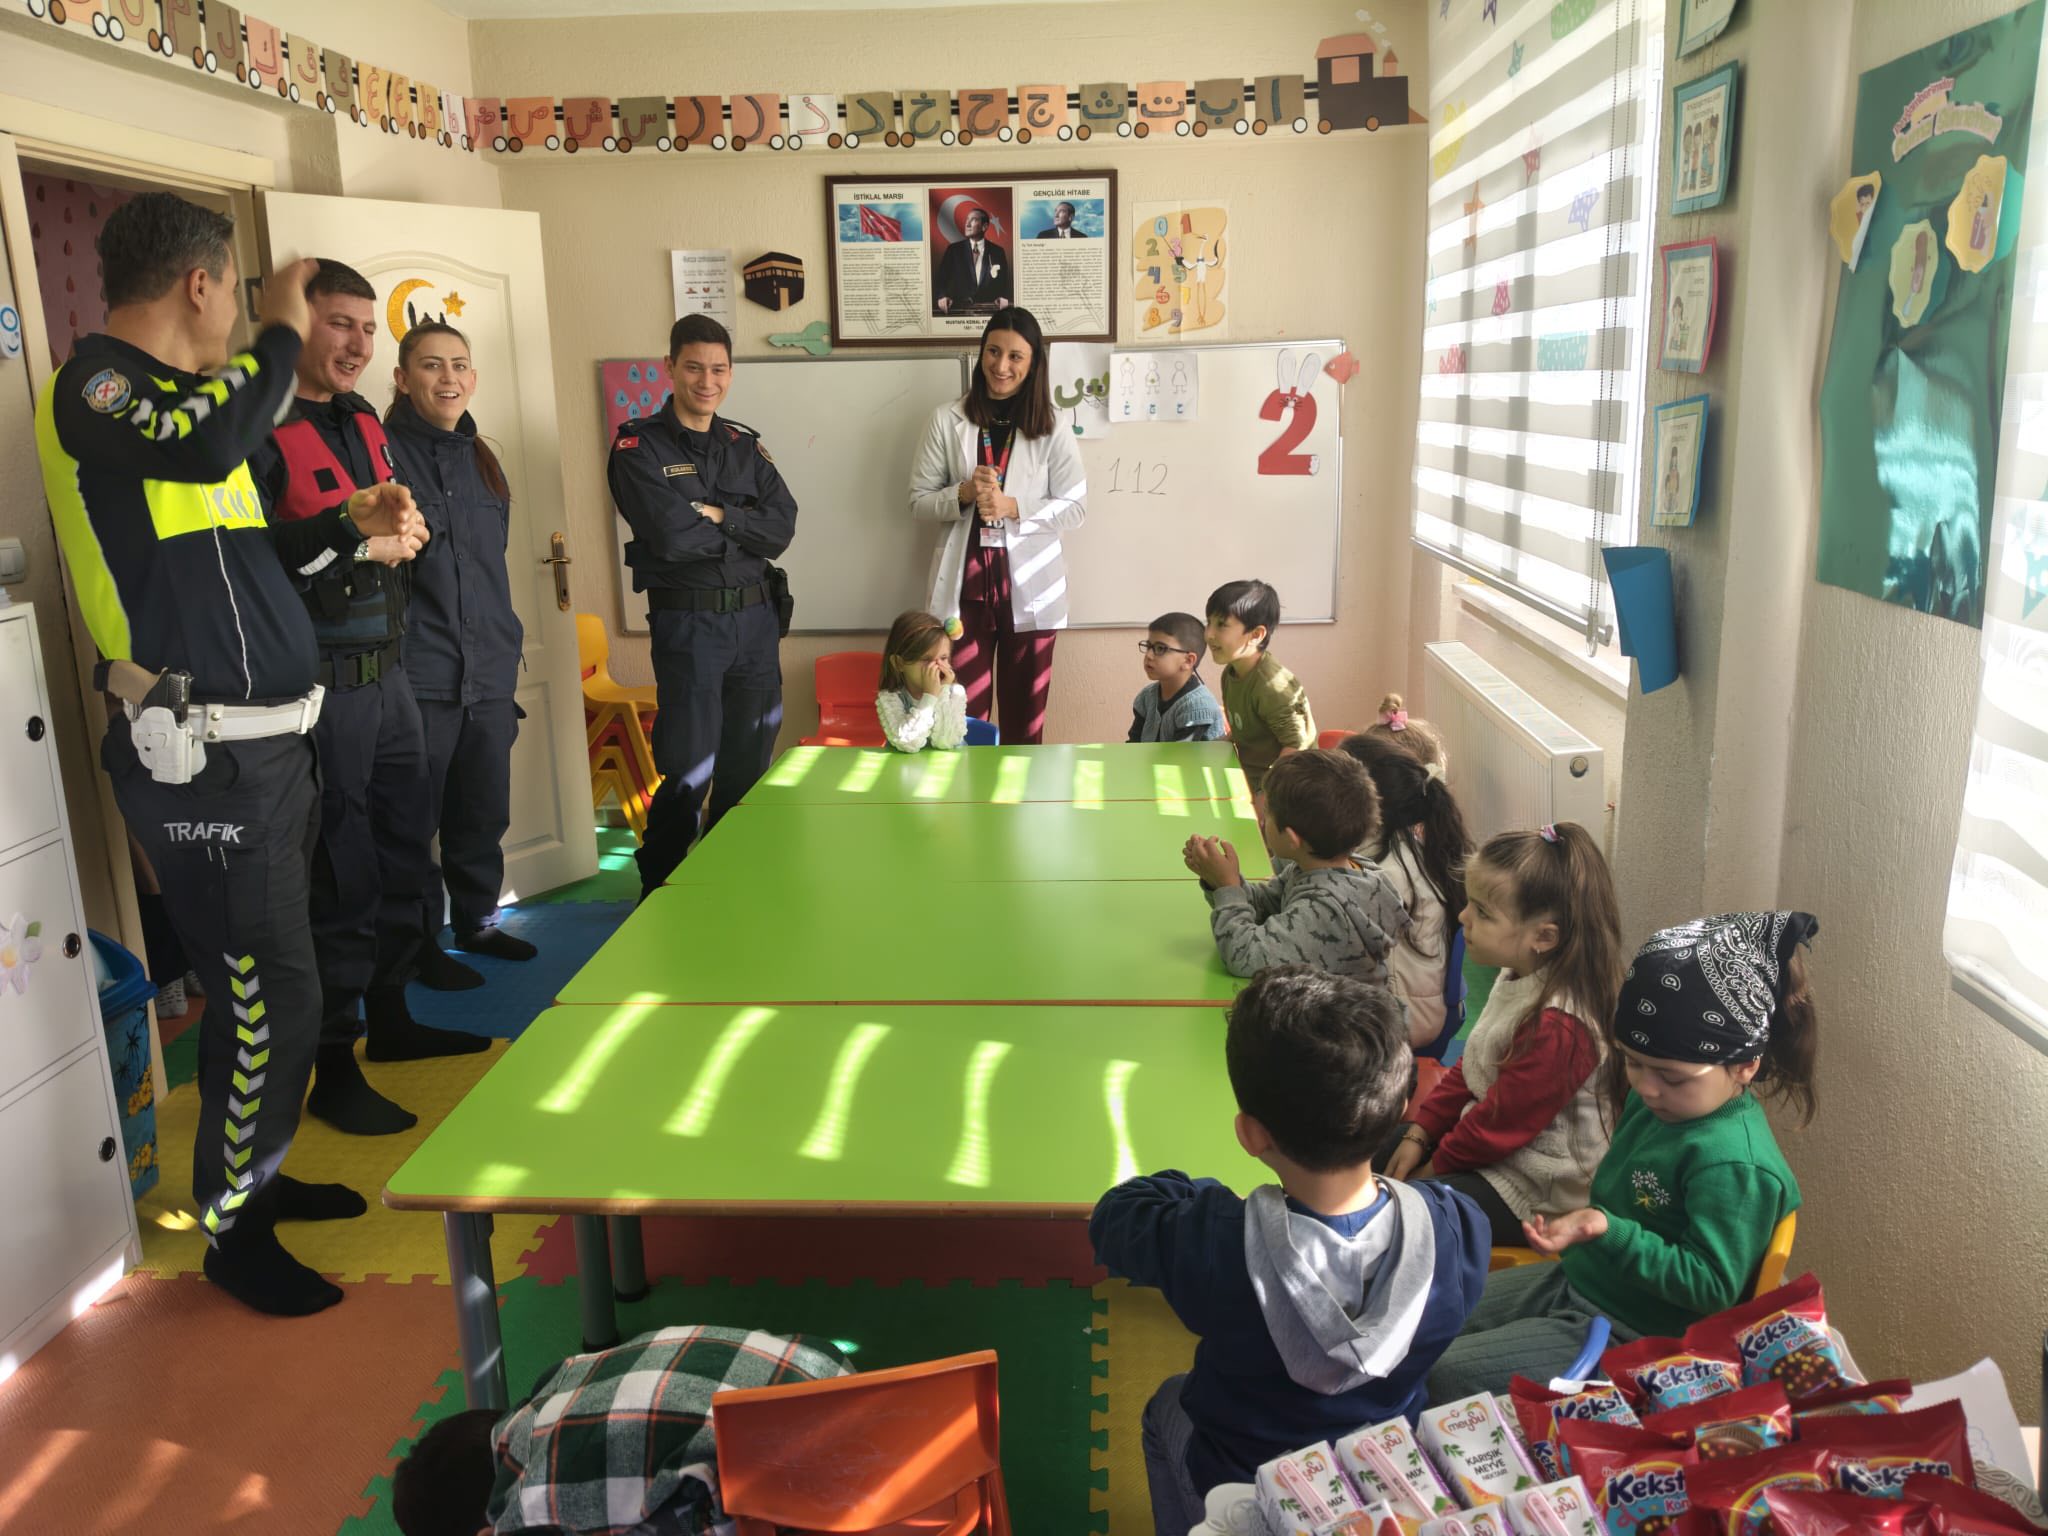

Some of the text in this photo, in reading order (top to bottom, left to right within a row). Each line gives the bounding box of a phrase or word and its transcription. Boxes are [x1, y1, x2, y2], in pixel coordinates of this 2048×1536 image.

[797, 96, 831, 136] ذ
[853, 98, 885, 137] د
[909, 91, 941, 139] خ
[966, 94, 1000, 137] ح
[1027, 93, 1054, 128] ج
[1081, 90, 1125, 120] ث
[1140, 96, 1185, 118] ت
[1200, 98, 1238, 125] ب
[1271, 78, 1282, 123] ا
[511, 105, 549, 139] ص
[566, 101, 603, 141] ش
[622, 113, 657, 143] س
[1154, 213, 1192, 237] 0 1
[1145, 238, 1183, 257] 2 3
[1171, 263, 1187, 283] 5
[1155, 285, 1170, 304] 6
[1148, 307, 1183, 327] 8 9
[1257, 386, 1320, 475] 2
[1107, 457, 1168, 495] 112
[1743, 1315, 1798, 1358] Kekst
[1637, 1360, 1722, 1394] Kekstra
[1554, 1391, 1622, 1419] Kekst
[1405, 1468, 1425, 1480] MIX
[1474, 1458, 1506, 1475] MEYVE
[1535, 1442, 1560, 1481] Keks
[1327, 1495, 1346, 1508] MIX
[1609, 1469, 1684, 1505] Kekst
